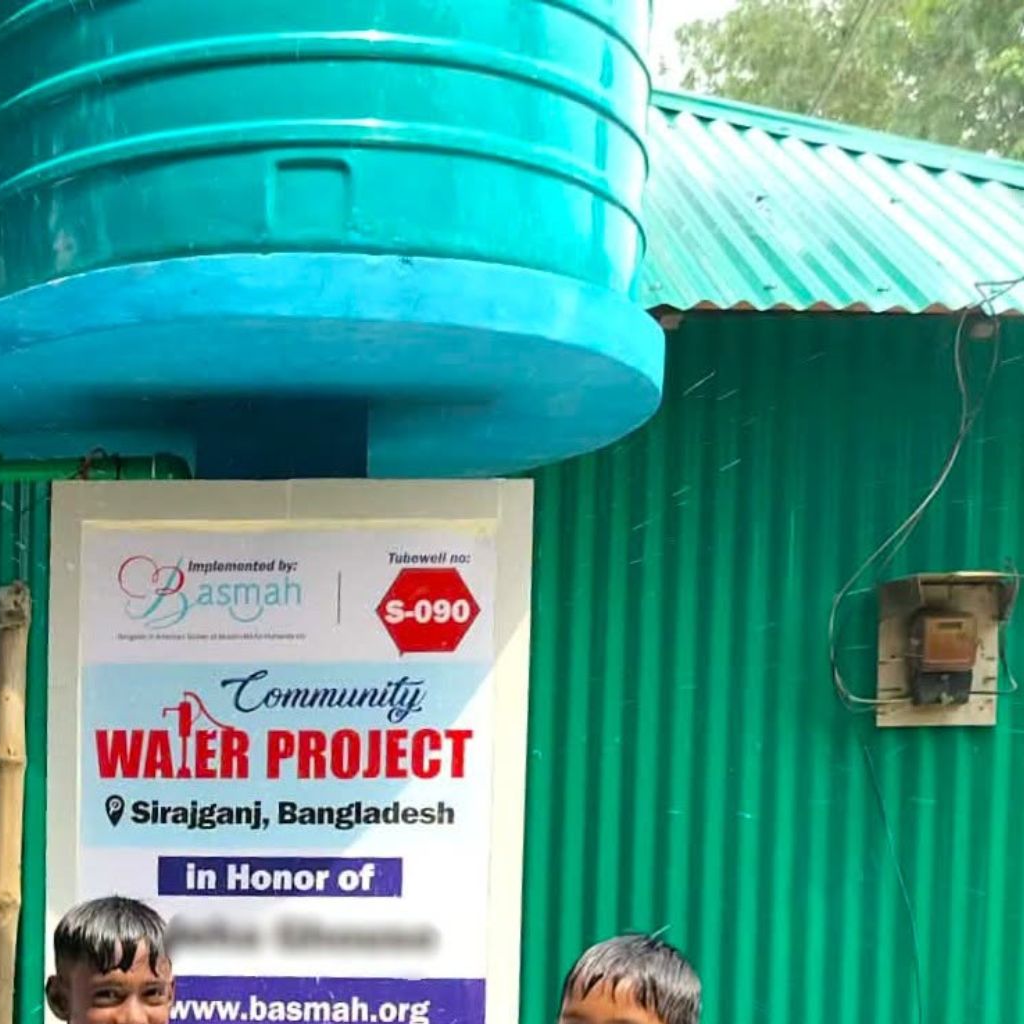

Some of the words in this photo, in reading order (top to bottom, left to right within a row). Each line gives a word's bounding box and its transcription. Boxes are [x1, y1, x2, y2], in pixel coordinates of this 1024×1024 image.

[188, 560, 275, 574] Implemented
[277, 559, 298, 574] by:
[389, 552, 447, 564] Tubewell
[450, 554, 472, 564] no:
[118, 555, 302, 629] Basmah
[383, 599, 471, 625] S-090
[221, 669, 426, 722] Community
[95, 714, 251, 780] WATER
[266, 727, 474, 780] PROJECT
[131, 800, 271, 830] Sirajganj,
[278, 801, 455, 830] Bangladesh
[185, 863, 216, 890] in
[226, 863, 330, 891] Honor
[337, 862, 375, 891] of
